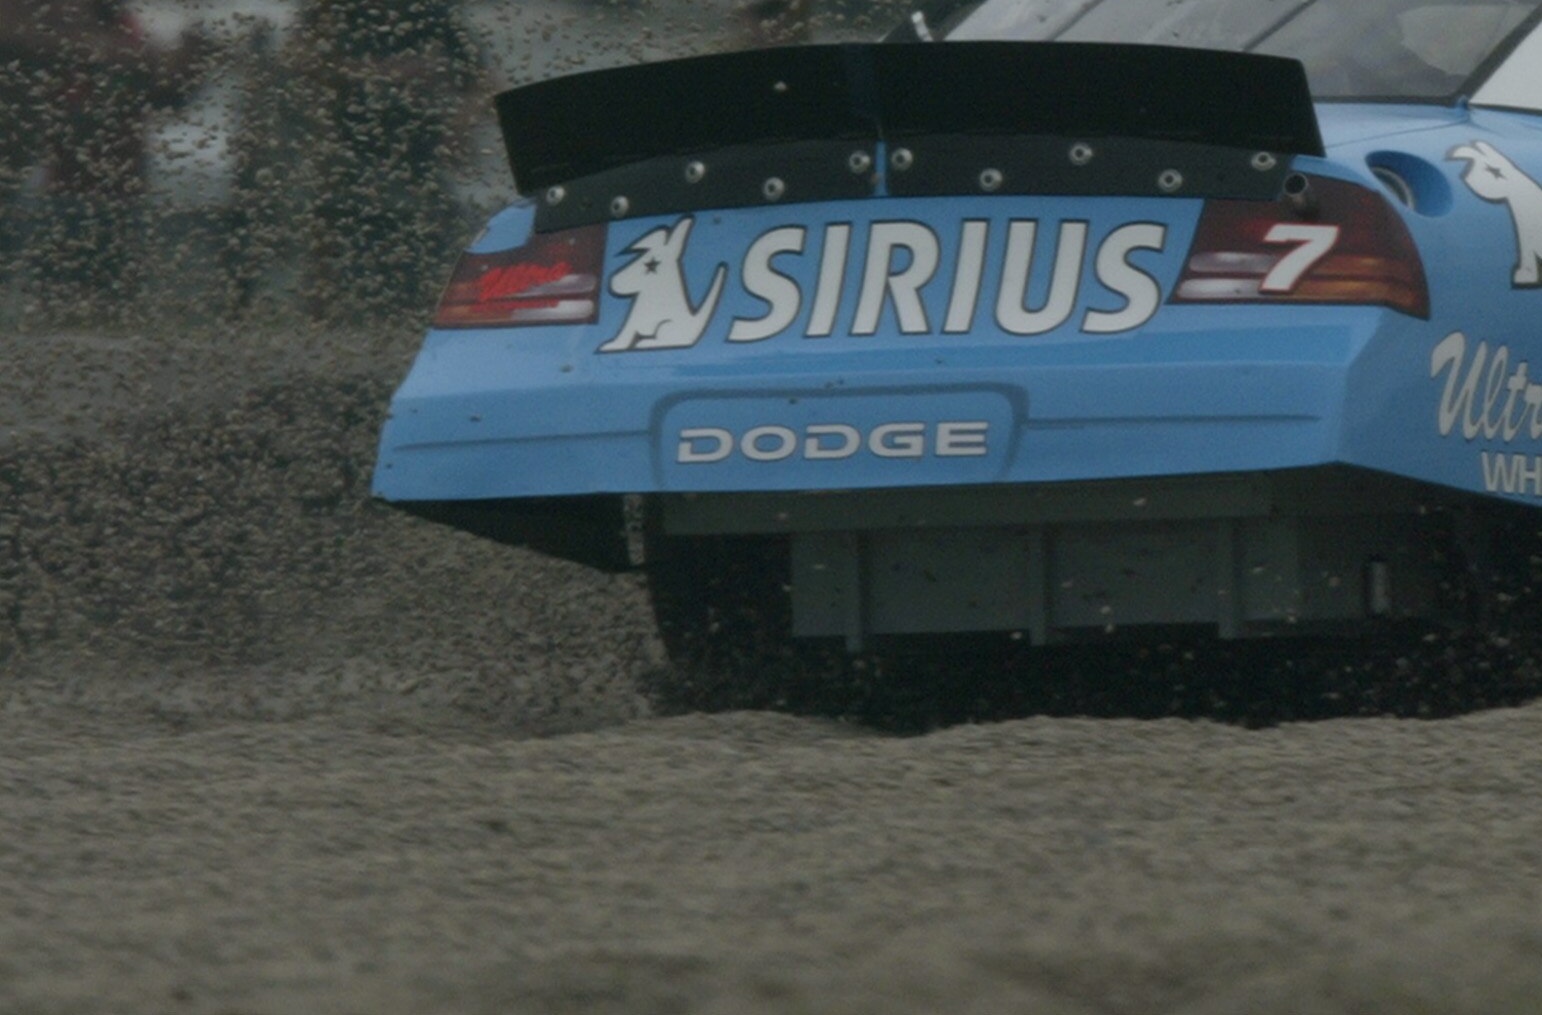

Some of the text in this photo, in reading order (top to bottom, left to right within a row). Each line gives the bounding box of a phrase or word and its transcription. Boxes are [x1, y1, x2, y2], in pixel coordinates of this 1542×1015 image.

[725, 216, 1168, 342] SIRIUS
[1258, 223, 1339, 294] 7
[676, 421, 990, 464] DODGE
